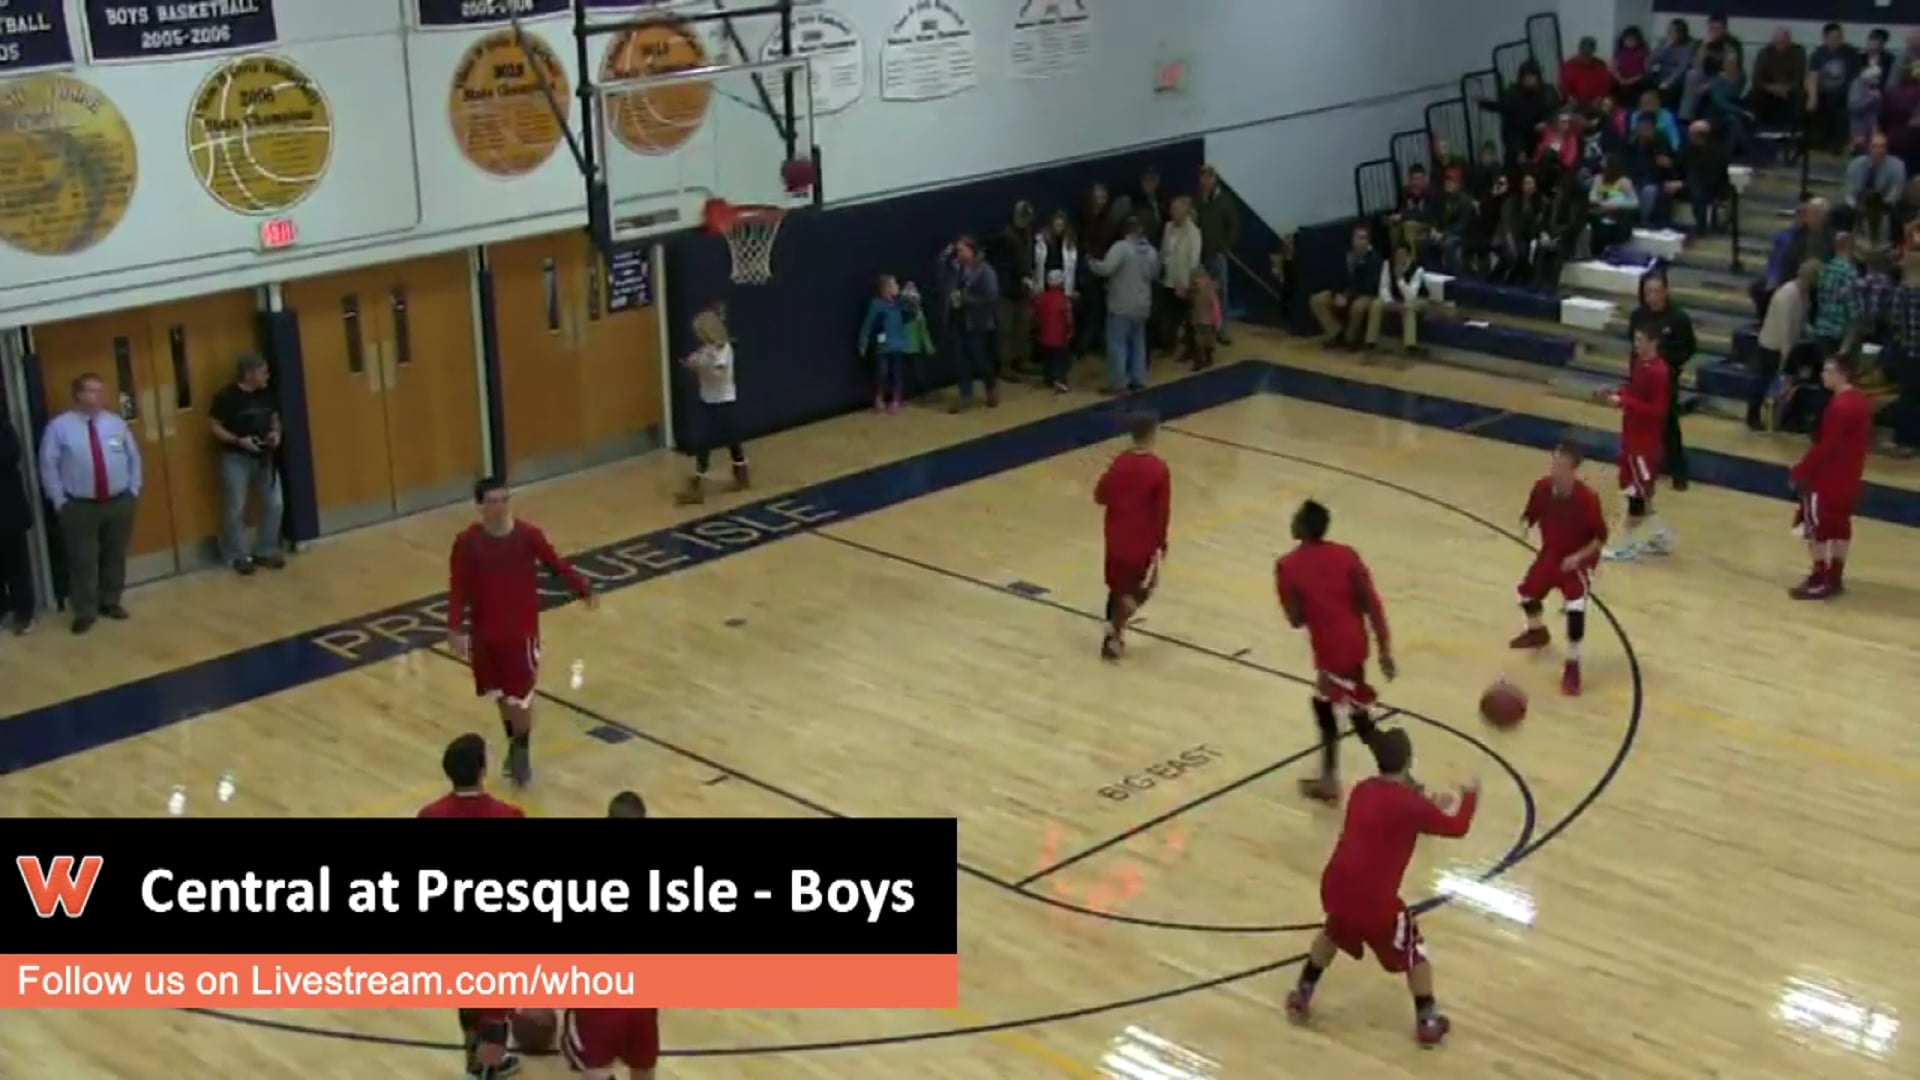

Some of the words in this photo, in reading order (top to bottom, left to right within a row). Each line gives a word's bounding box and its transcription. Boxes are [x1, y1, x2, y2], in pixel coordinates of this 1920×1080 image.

[105, 6, 149, 25] BOYS
[157, 0, 259, 22] BASKETBALL
[141, 25, 232, 49] 2005-2006
[675, 497, 840, 549] ISLE
[1097, 773, 1156, 801] BIG
[1144, 743, 1223, 780] EAST
